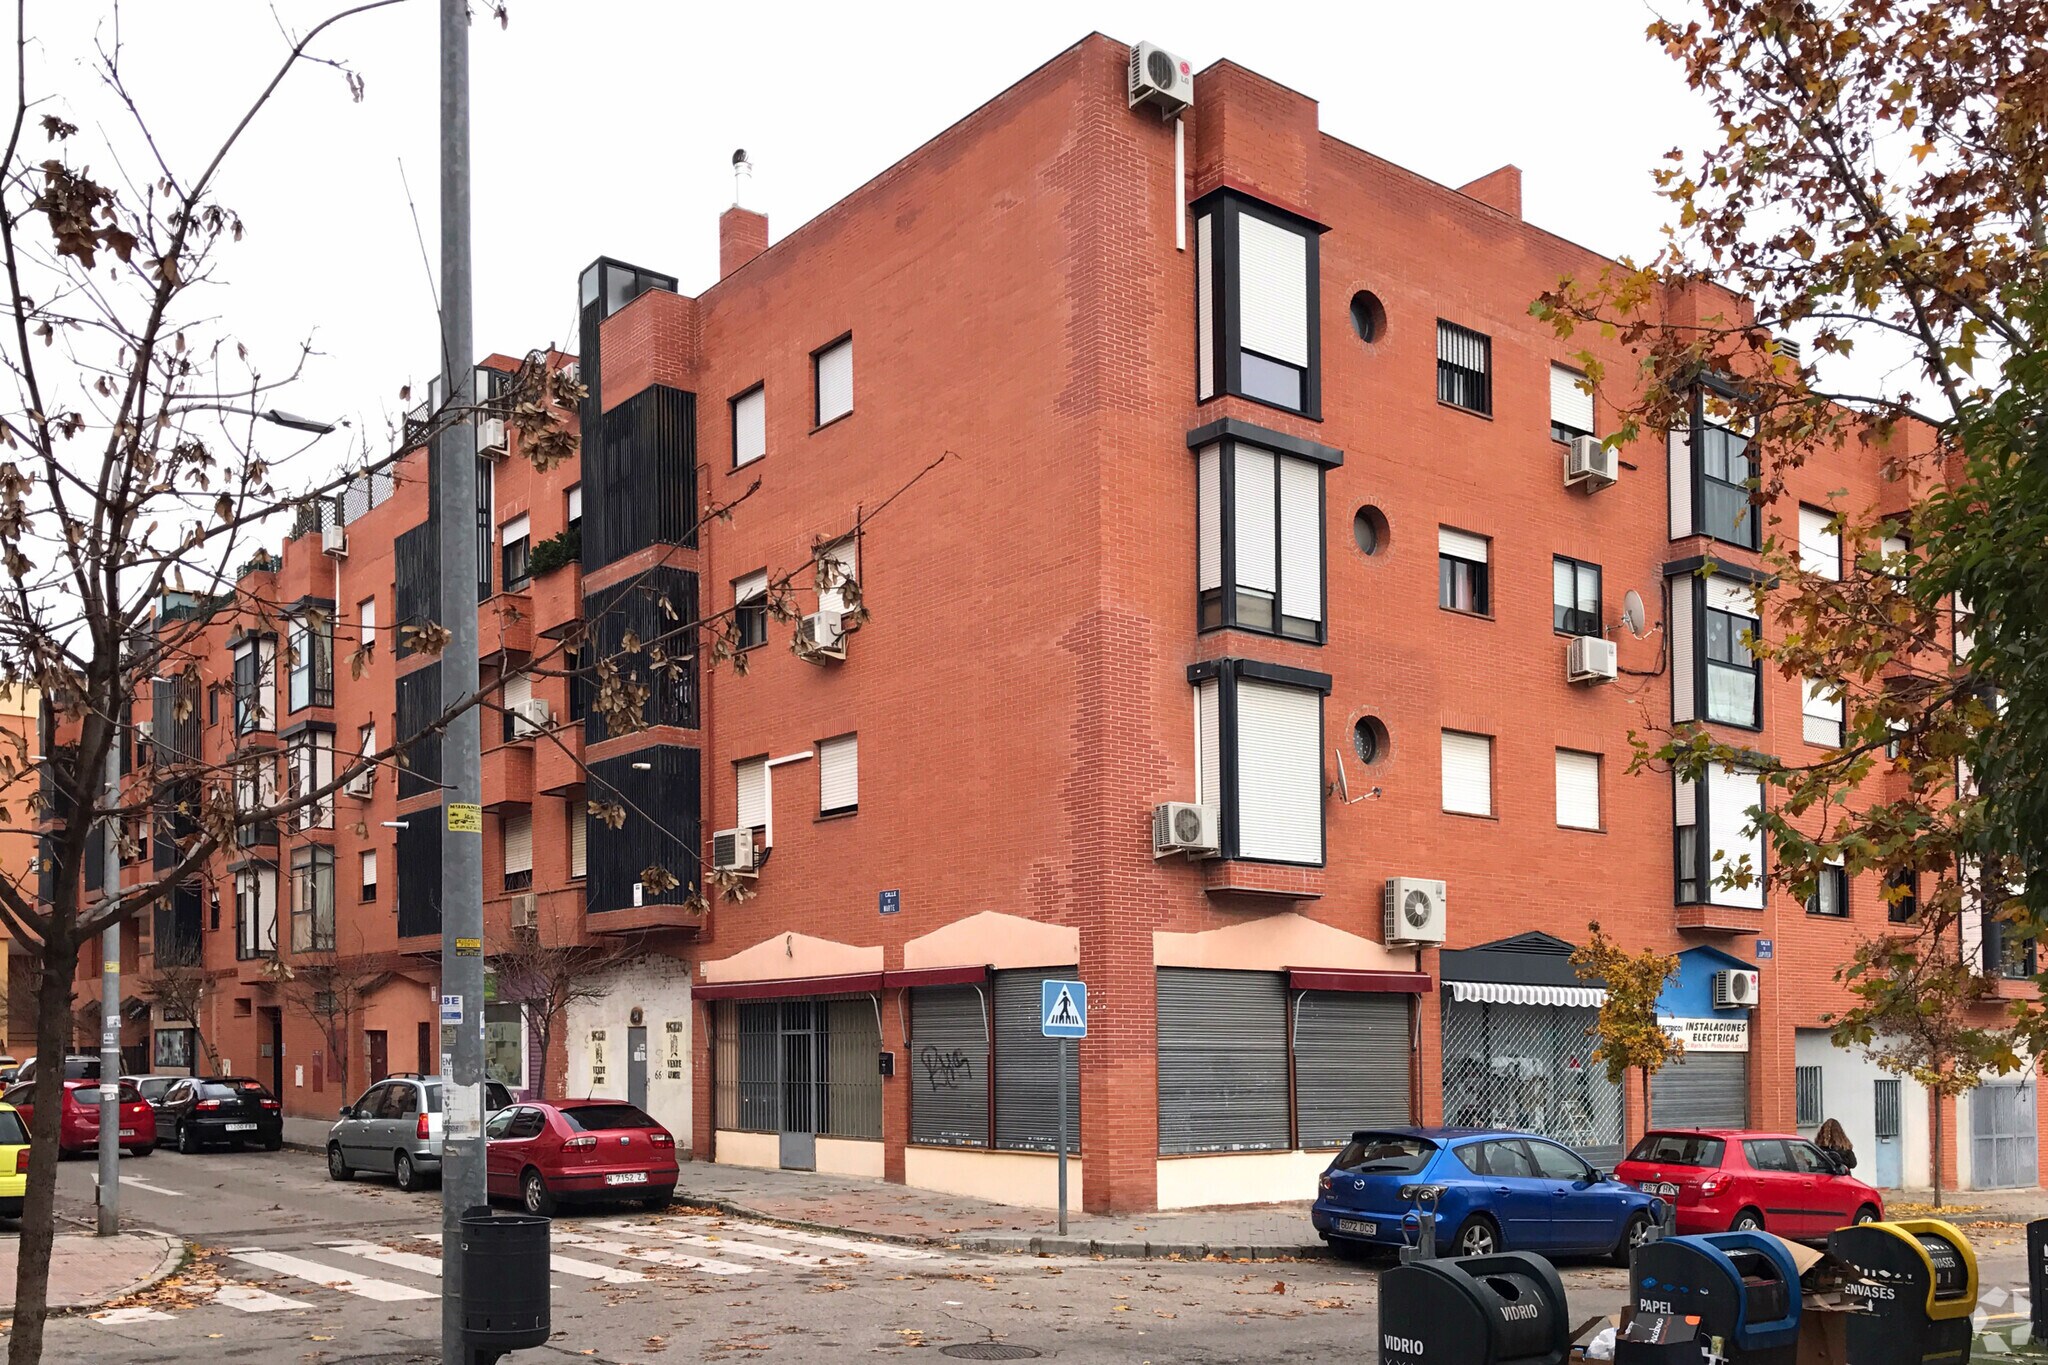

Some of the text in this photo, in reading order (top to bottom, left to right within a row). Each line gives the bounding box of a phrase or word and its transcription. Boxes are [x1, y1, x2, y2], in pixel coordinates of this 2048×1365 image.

[1685, 1022, 1747, 1032] INSTALACIONES
[1692, 1033, 1740, 1043] ELECTRICAS
[616, 1173, 634, 1182] 7152
[1643, 1184, 1658, 1193] 367
[1360, 1223, 1375, 1234] DCS
[1931, 1256, 1956, 1269] NVASES
[1845, 1283, 1896, 1300] ENVASES
[1640, 1298, 1675, 1315] PAPEL
[1500, 1304, 1539, 1322] VIDRIO
[1384, 1334, 1424, 1356] VIDRIO
